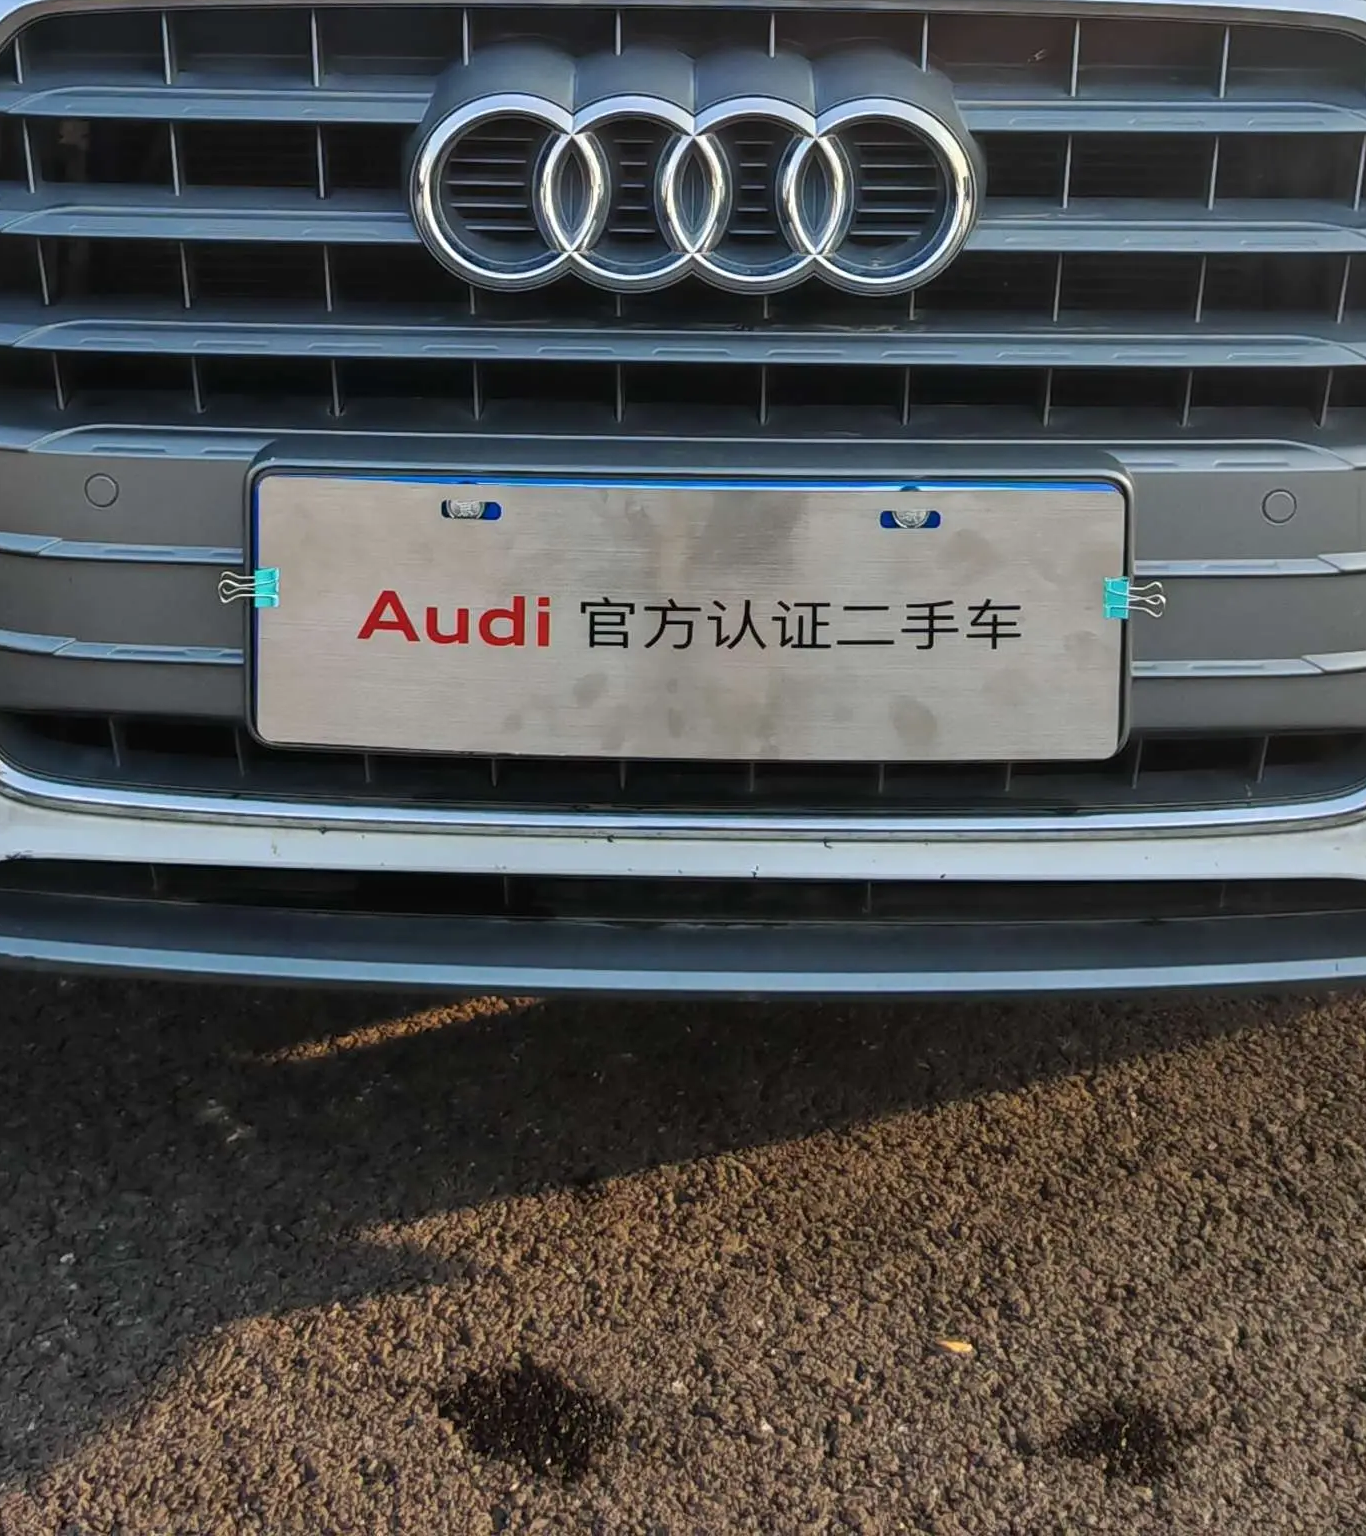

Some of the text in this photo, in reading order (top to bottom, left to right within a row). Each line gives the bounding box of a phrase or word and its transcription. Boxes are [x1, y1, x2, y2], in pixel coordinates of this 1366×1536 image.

[358, 591, 1022, 650] Audi 官方认证二手车
